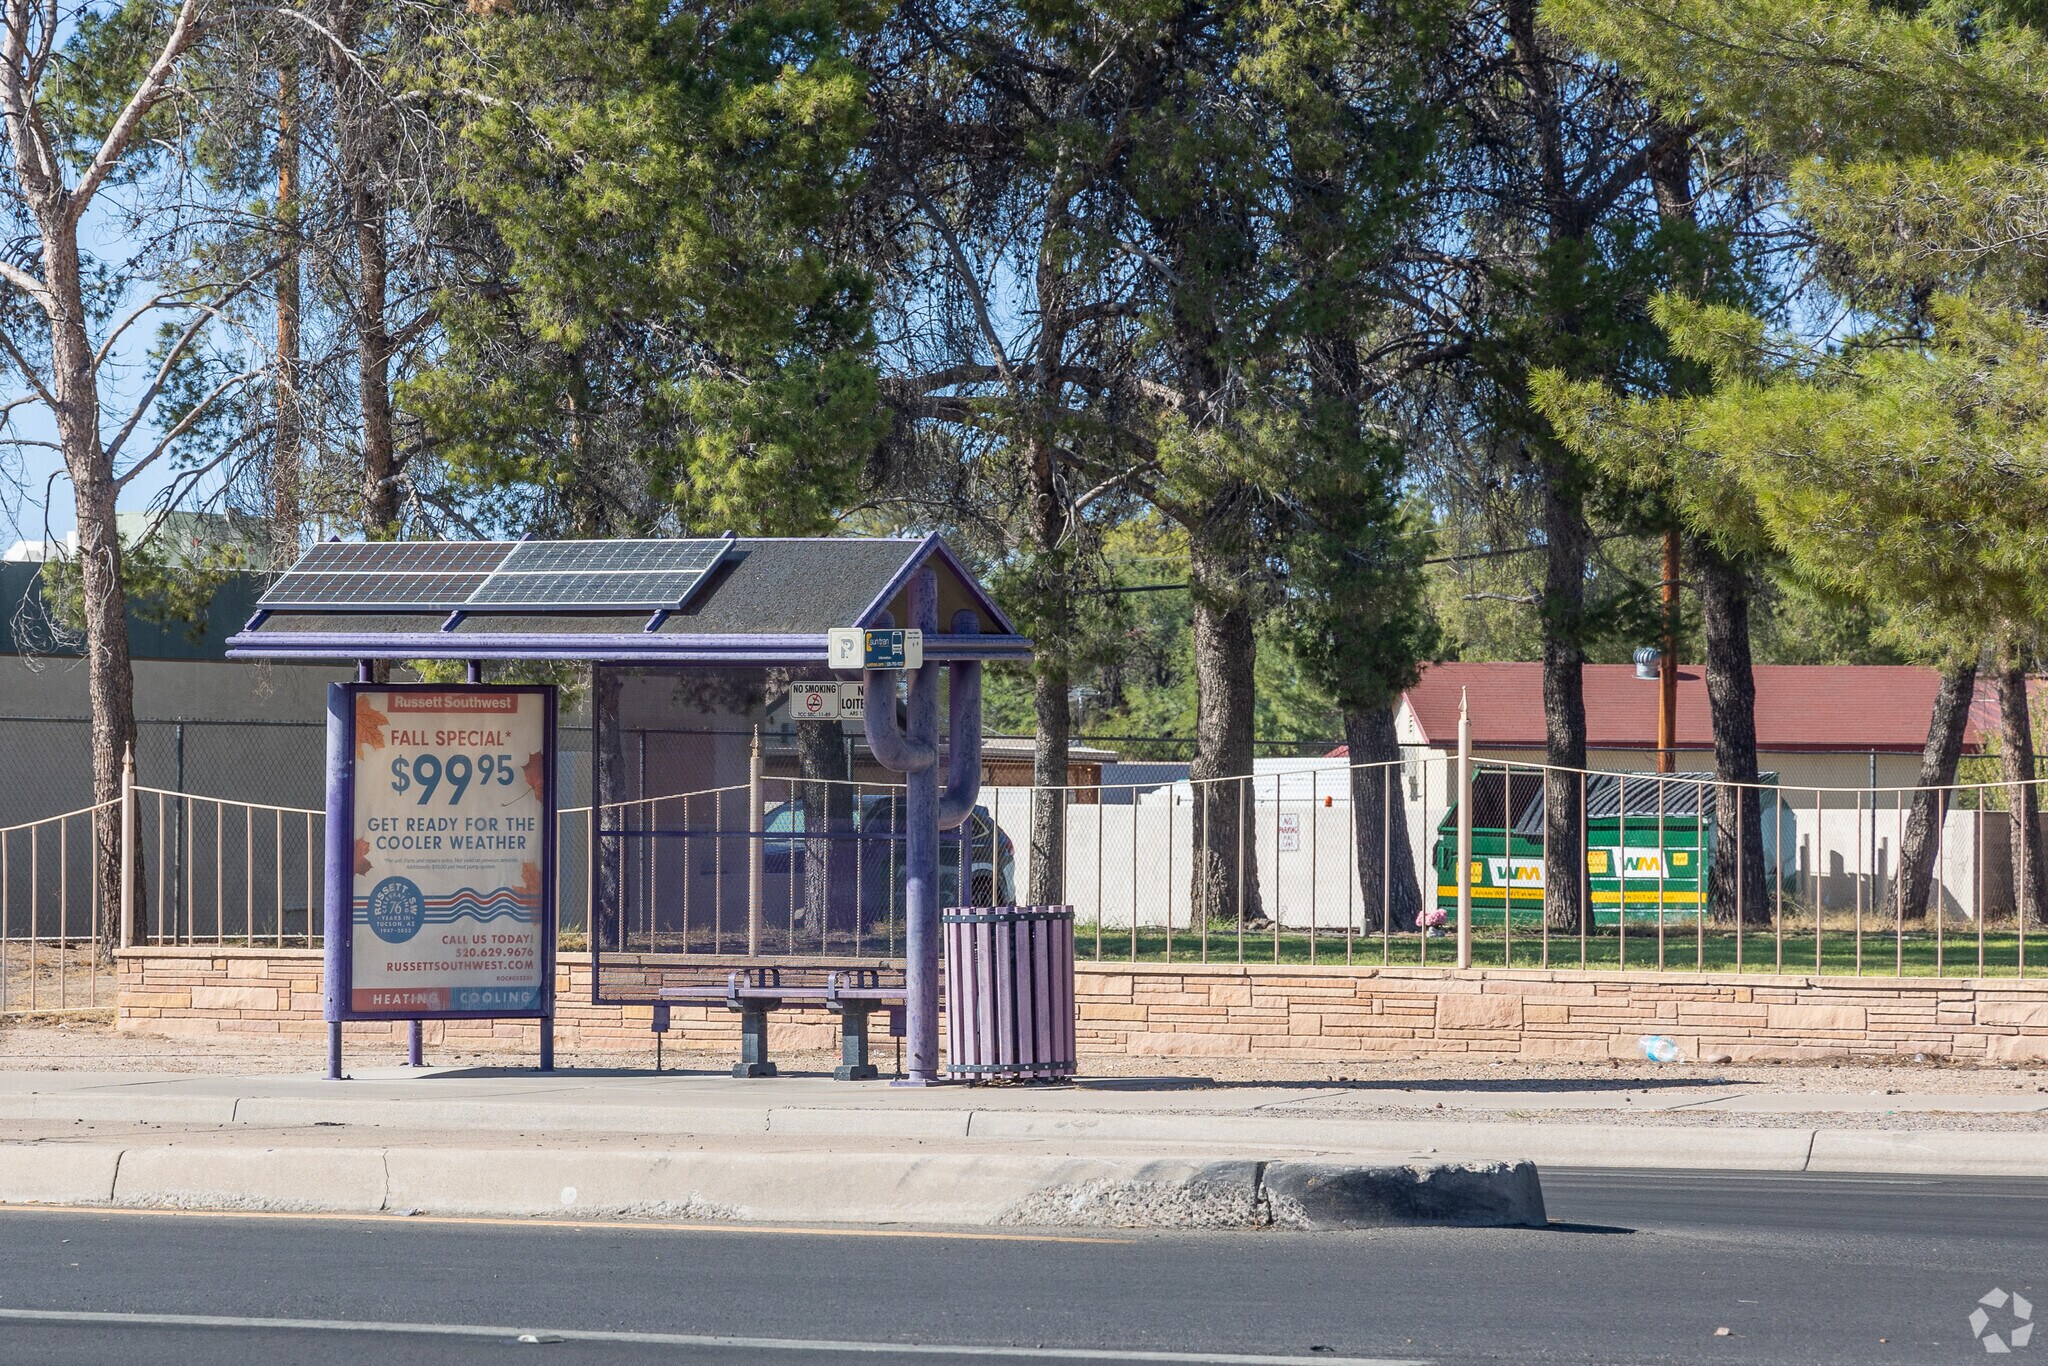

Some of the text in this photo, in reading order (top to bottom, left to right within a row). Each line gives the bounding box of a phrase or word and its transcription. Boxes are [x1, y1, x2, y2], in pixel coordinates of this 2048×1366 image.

[793, 684, 836, 693] NO SMOKING
[857, 685, 864, 696] N
[394, 696, 511, 709] Russett Southwest
[841, 698, 864, 709] LOITE
[391, 730, 429, 746] FALL
[367, 817, 535, 832] GET READY FOR THE
[376, 835, 527, 850] COOLER WEATHER
[1619, 856, 1660, 871] WM
[1496, 866, 1541, 880] WM
[374, 883, 418, 915] RUSSETT SW
[390, 901, 402, 915] 76
[442, 934, 534, 945] CALL US TODAY!
[456, 947, 534, 958] 520.629.9676
[386, 960, 534, 972] RUSSETTSOUTHWEST.COM
[373, 991, 439, 1005] HEATING
[459, 991, 532, 1004] COOLING
